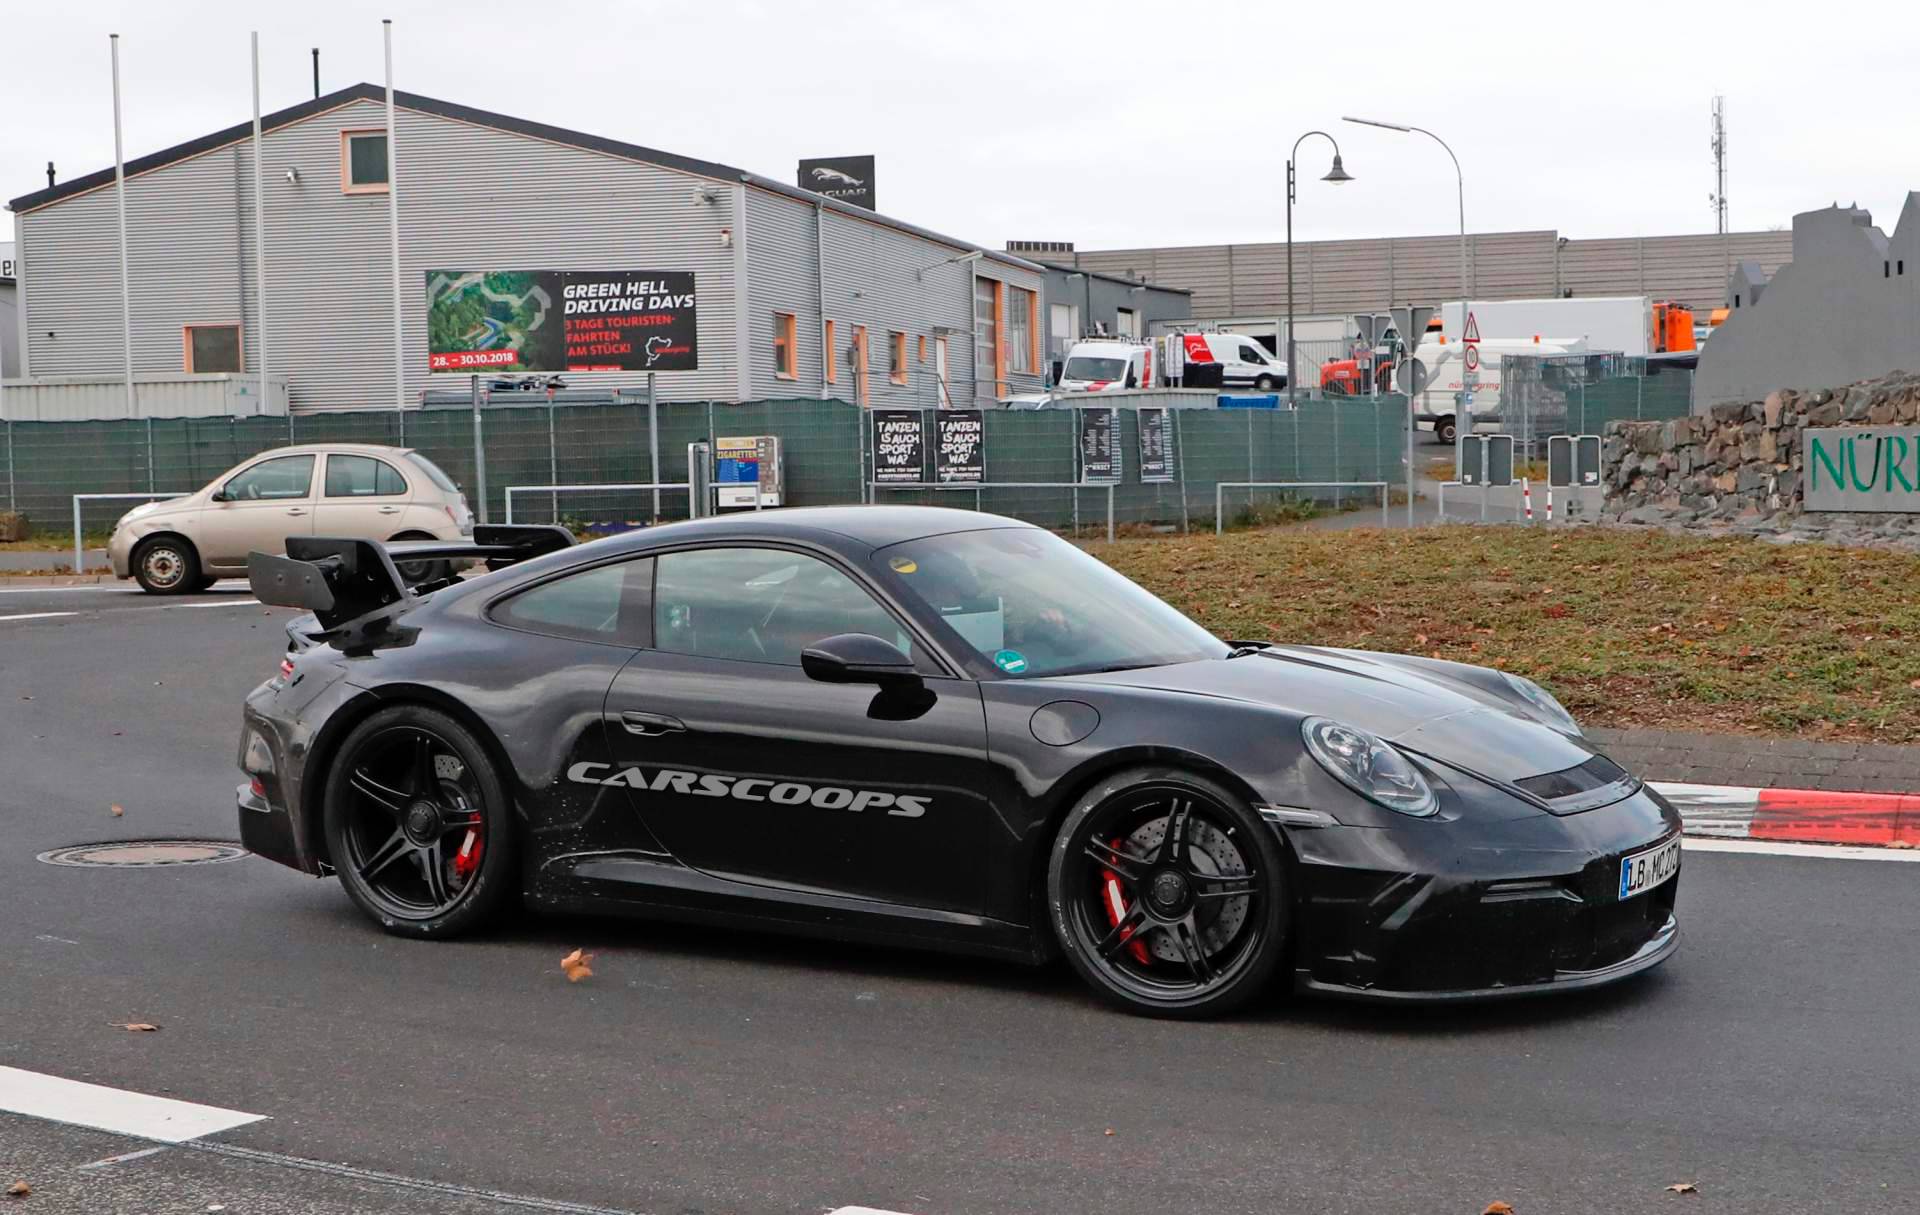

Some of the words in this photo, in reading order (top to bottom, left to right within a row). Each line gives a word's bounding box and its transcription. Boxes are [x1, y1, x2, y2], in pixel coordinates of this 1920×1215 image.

[563, 282, 621, 299] GREEN
[626, 280, 669, 296] HELL
[564, 297, 643, 314] DRIVING
[648, 294, 695, 310] DAYS
[575, 318, 605, 329] TAGE
[607, 315, 675, 327] TOURISTEN-
[567, 331, 620, 343] FAHRTEN
[568, 345, 587, 356] AM
[590, 342, 631, 356] STÜCK!
[433, 357, 449, 366] 28.
[461, 352, 513, 365] 30.10.2018
[878, 421, 920, 433] TANZEN
[940, 421, 981, 432] TANZEN
[881, 432, 891, 443] IS
[892, 434, 920, 445] AUCH
[943, 432, 953, 442] IS
[953, 433, 980, 444] AUCH
[887, 454, 909, 465] WA?
[949, 453, 970, 464] WA?
